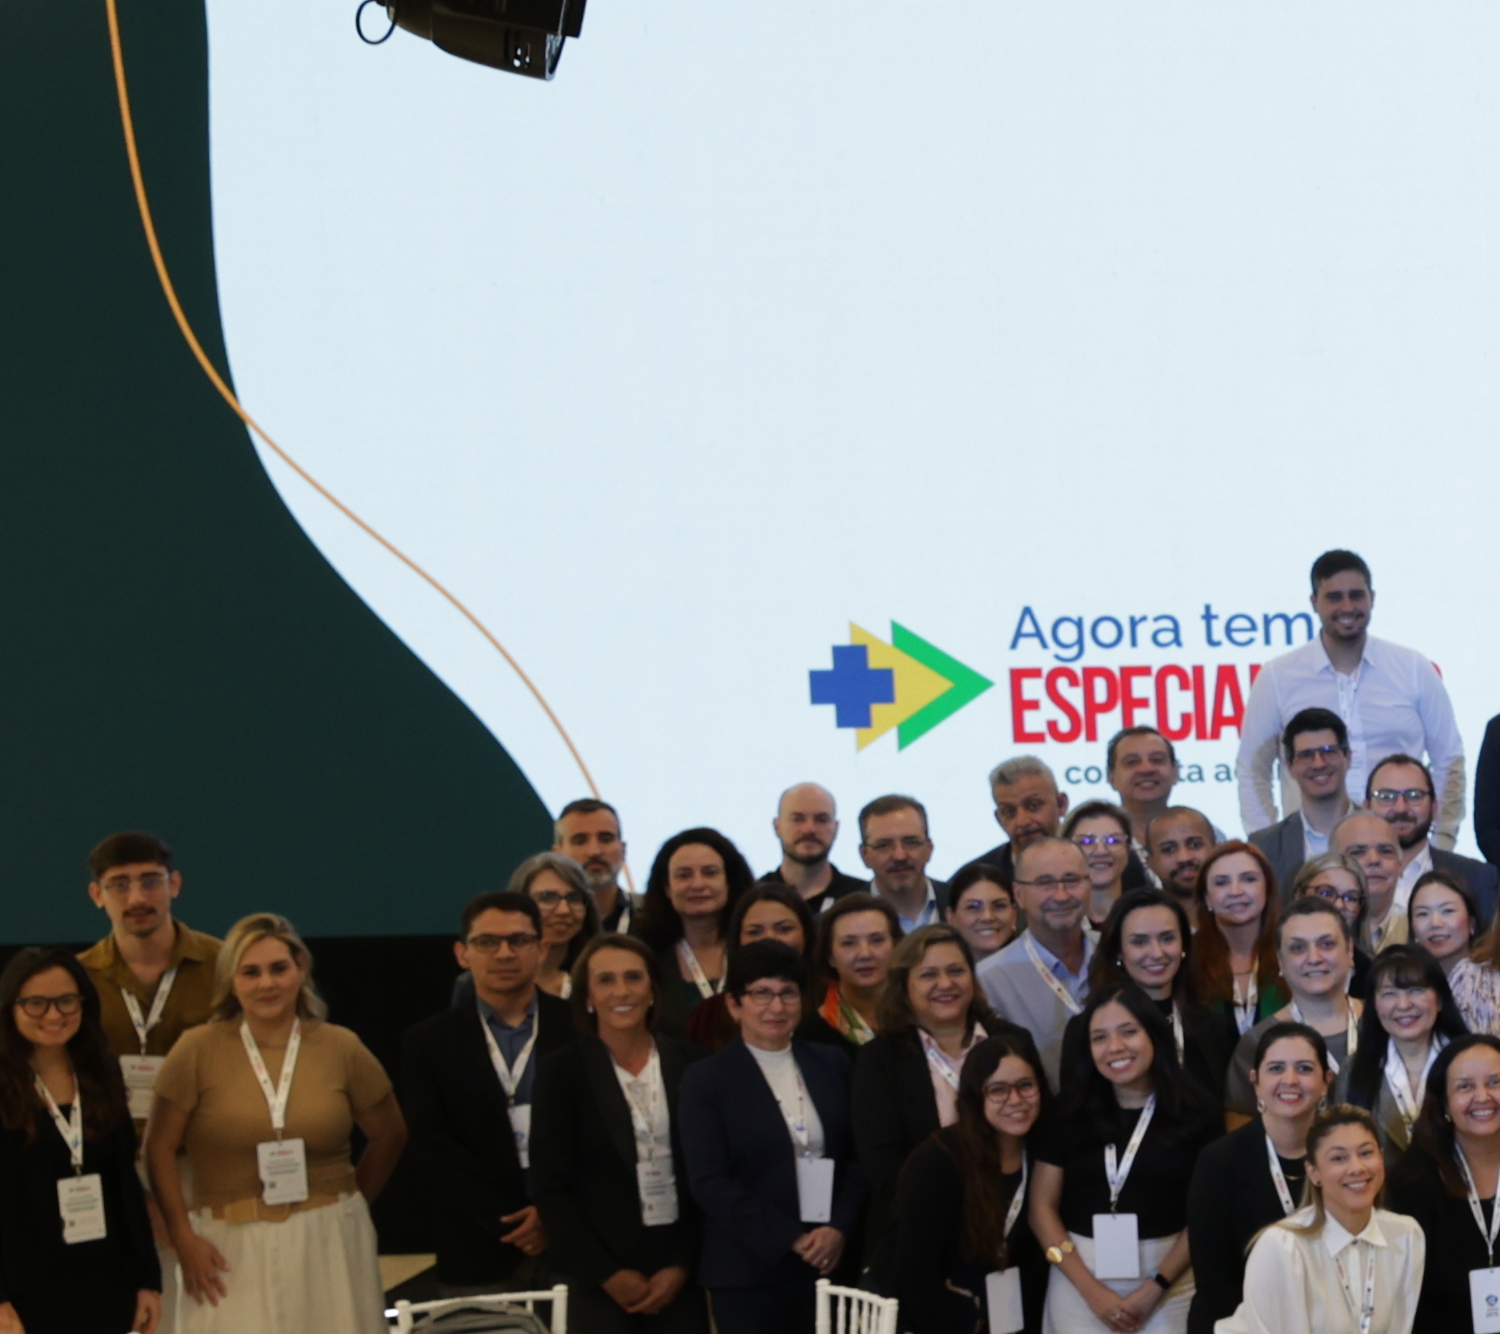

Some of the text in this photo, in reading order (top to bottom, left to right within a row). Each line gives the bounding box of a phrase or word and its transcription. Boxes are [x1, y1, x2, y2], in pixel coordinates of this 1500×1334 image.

[1009, 603, 1314, 663] Agora tem
[1008, 663, 1263, 745] ESPECIA
